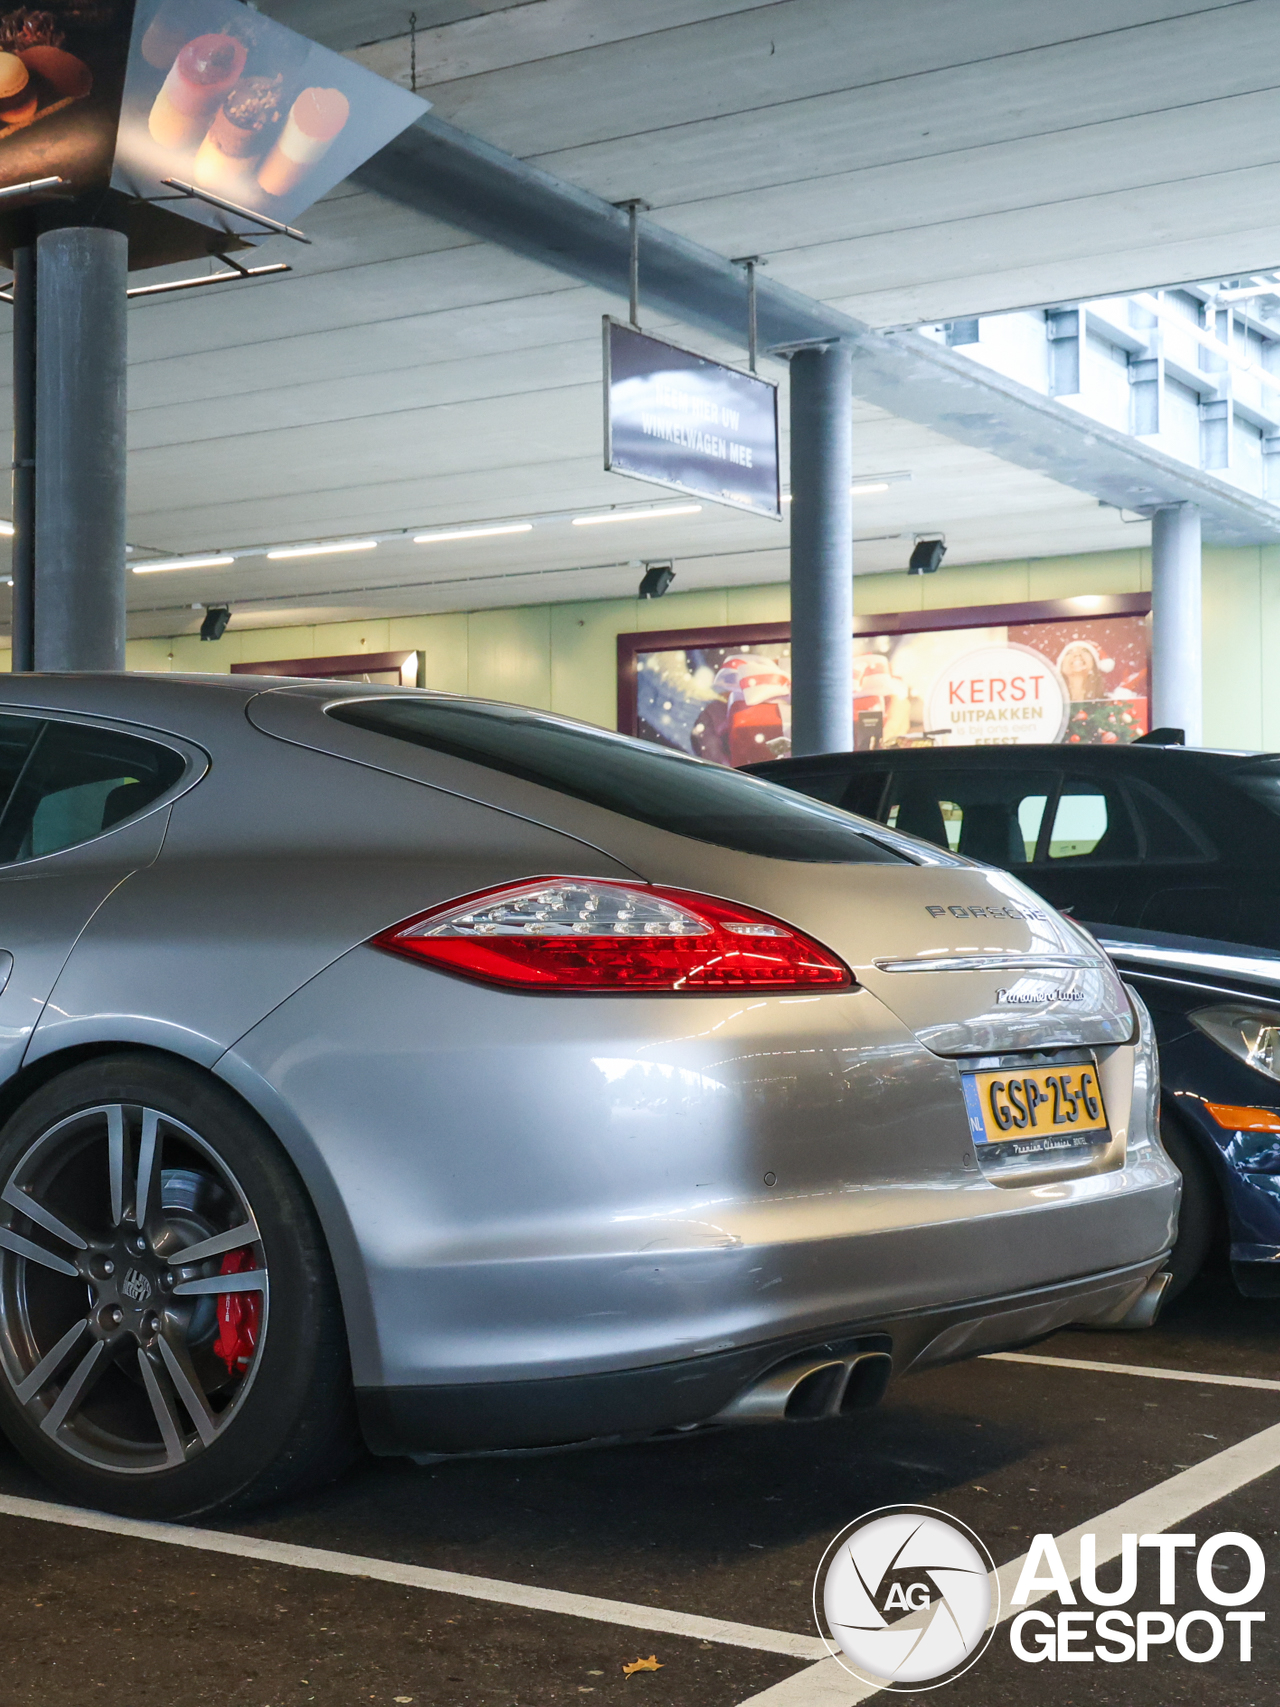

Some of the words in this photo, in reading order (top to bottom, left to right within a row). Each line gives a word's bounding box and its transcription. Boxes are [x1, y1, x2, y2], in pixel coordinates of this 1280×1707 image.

[691, 396, 719, 425] HIER
[721, 406, 740, 432] UW
[642, 411, 727, 460] WINKELWAGEN
[729, 442, 753, 468] MEE
[948, 675, 1045, 705] KERST
[950, 706, 1043, 724] UITPAKKEN
[986, 723, 1009, 733] ons
[924, 905, 1048, 922] PORSCHE
[989, 1073, 1100, 1131] GSP-25-G
[970, 1117, 984, 1132] NL
